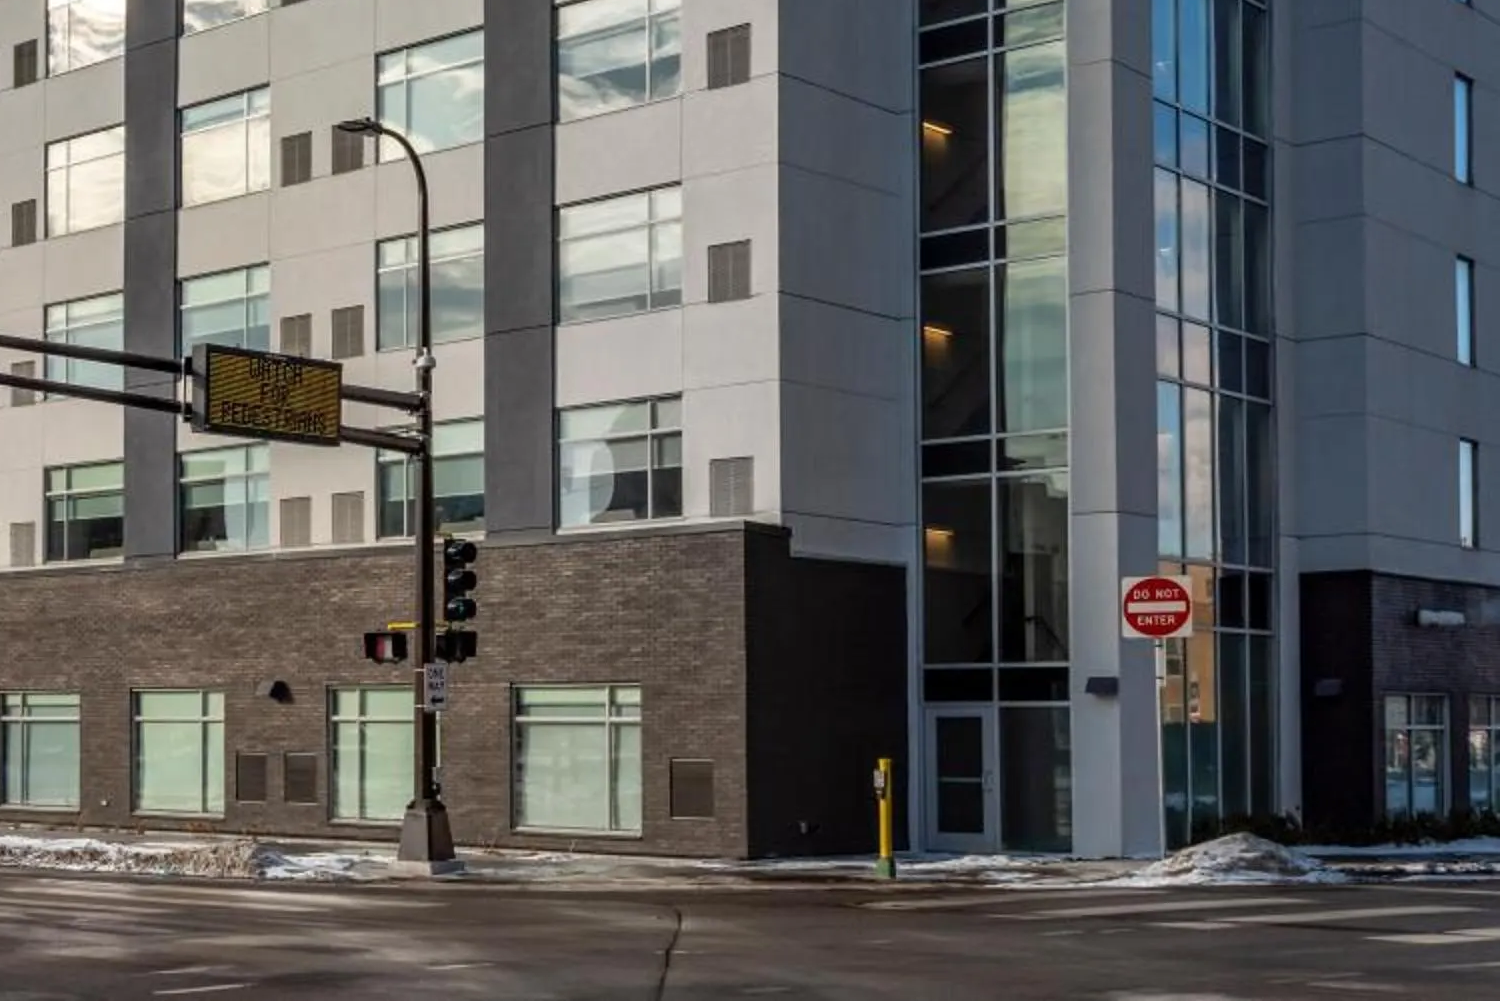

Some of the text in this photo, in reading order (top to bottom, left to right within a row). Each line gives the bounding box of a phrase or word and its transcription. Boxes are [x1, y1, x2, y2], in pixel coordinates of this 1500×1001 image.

[1133, 588, 1180, 599] DO NOT
[1137, 614, 1175, 626] ENTER
